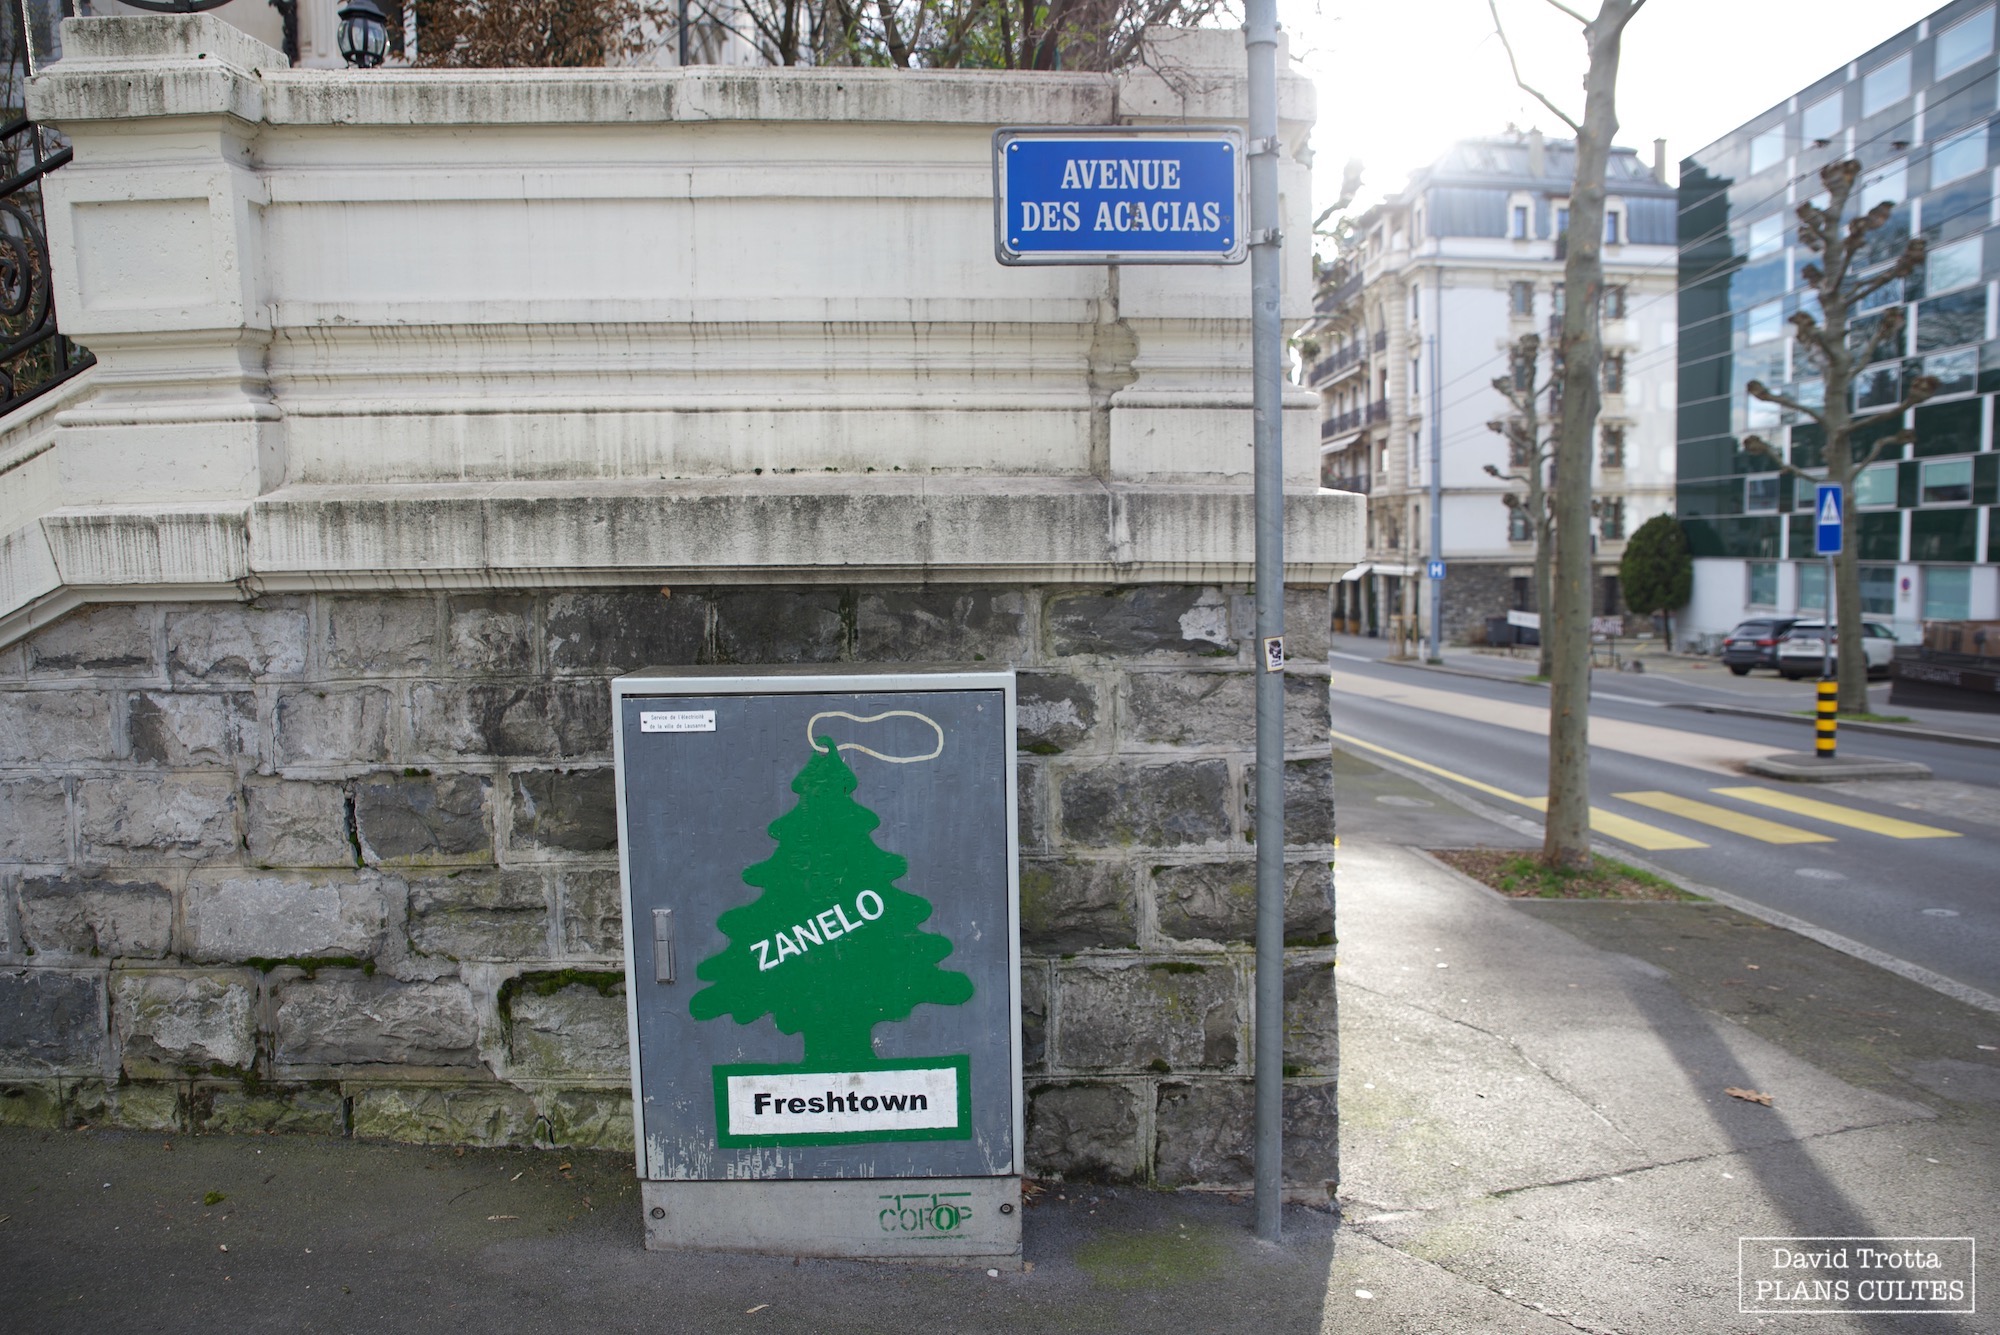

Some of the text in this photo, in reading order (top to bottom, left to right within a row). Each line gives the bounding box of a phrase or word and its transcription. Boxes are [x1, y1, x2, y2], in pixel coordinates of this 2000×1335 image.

[1061, 159, 1181, 190] AVENUE
[1021, 201, 1221, 233] DES ACACIAS
[1431, 563, 1443, 577] H
[750, 889, 884, 971] ZANELO
[754, 1091, 928, 1115] Freshtown
